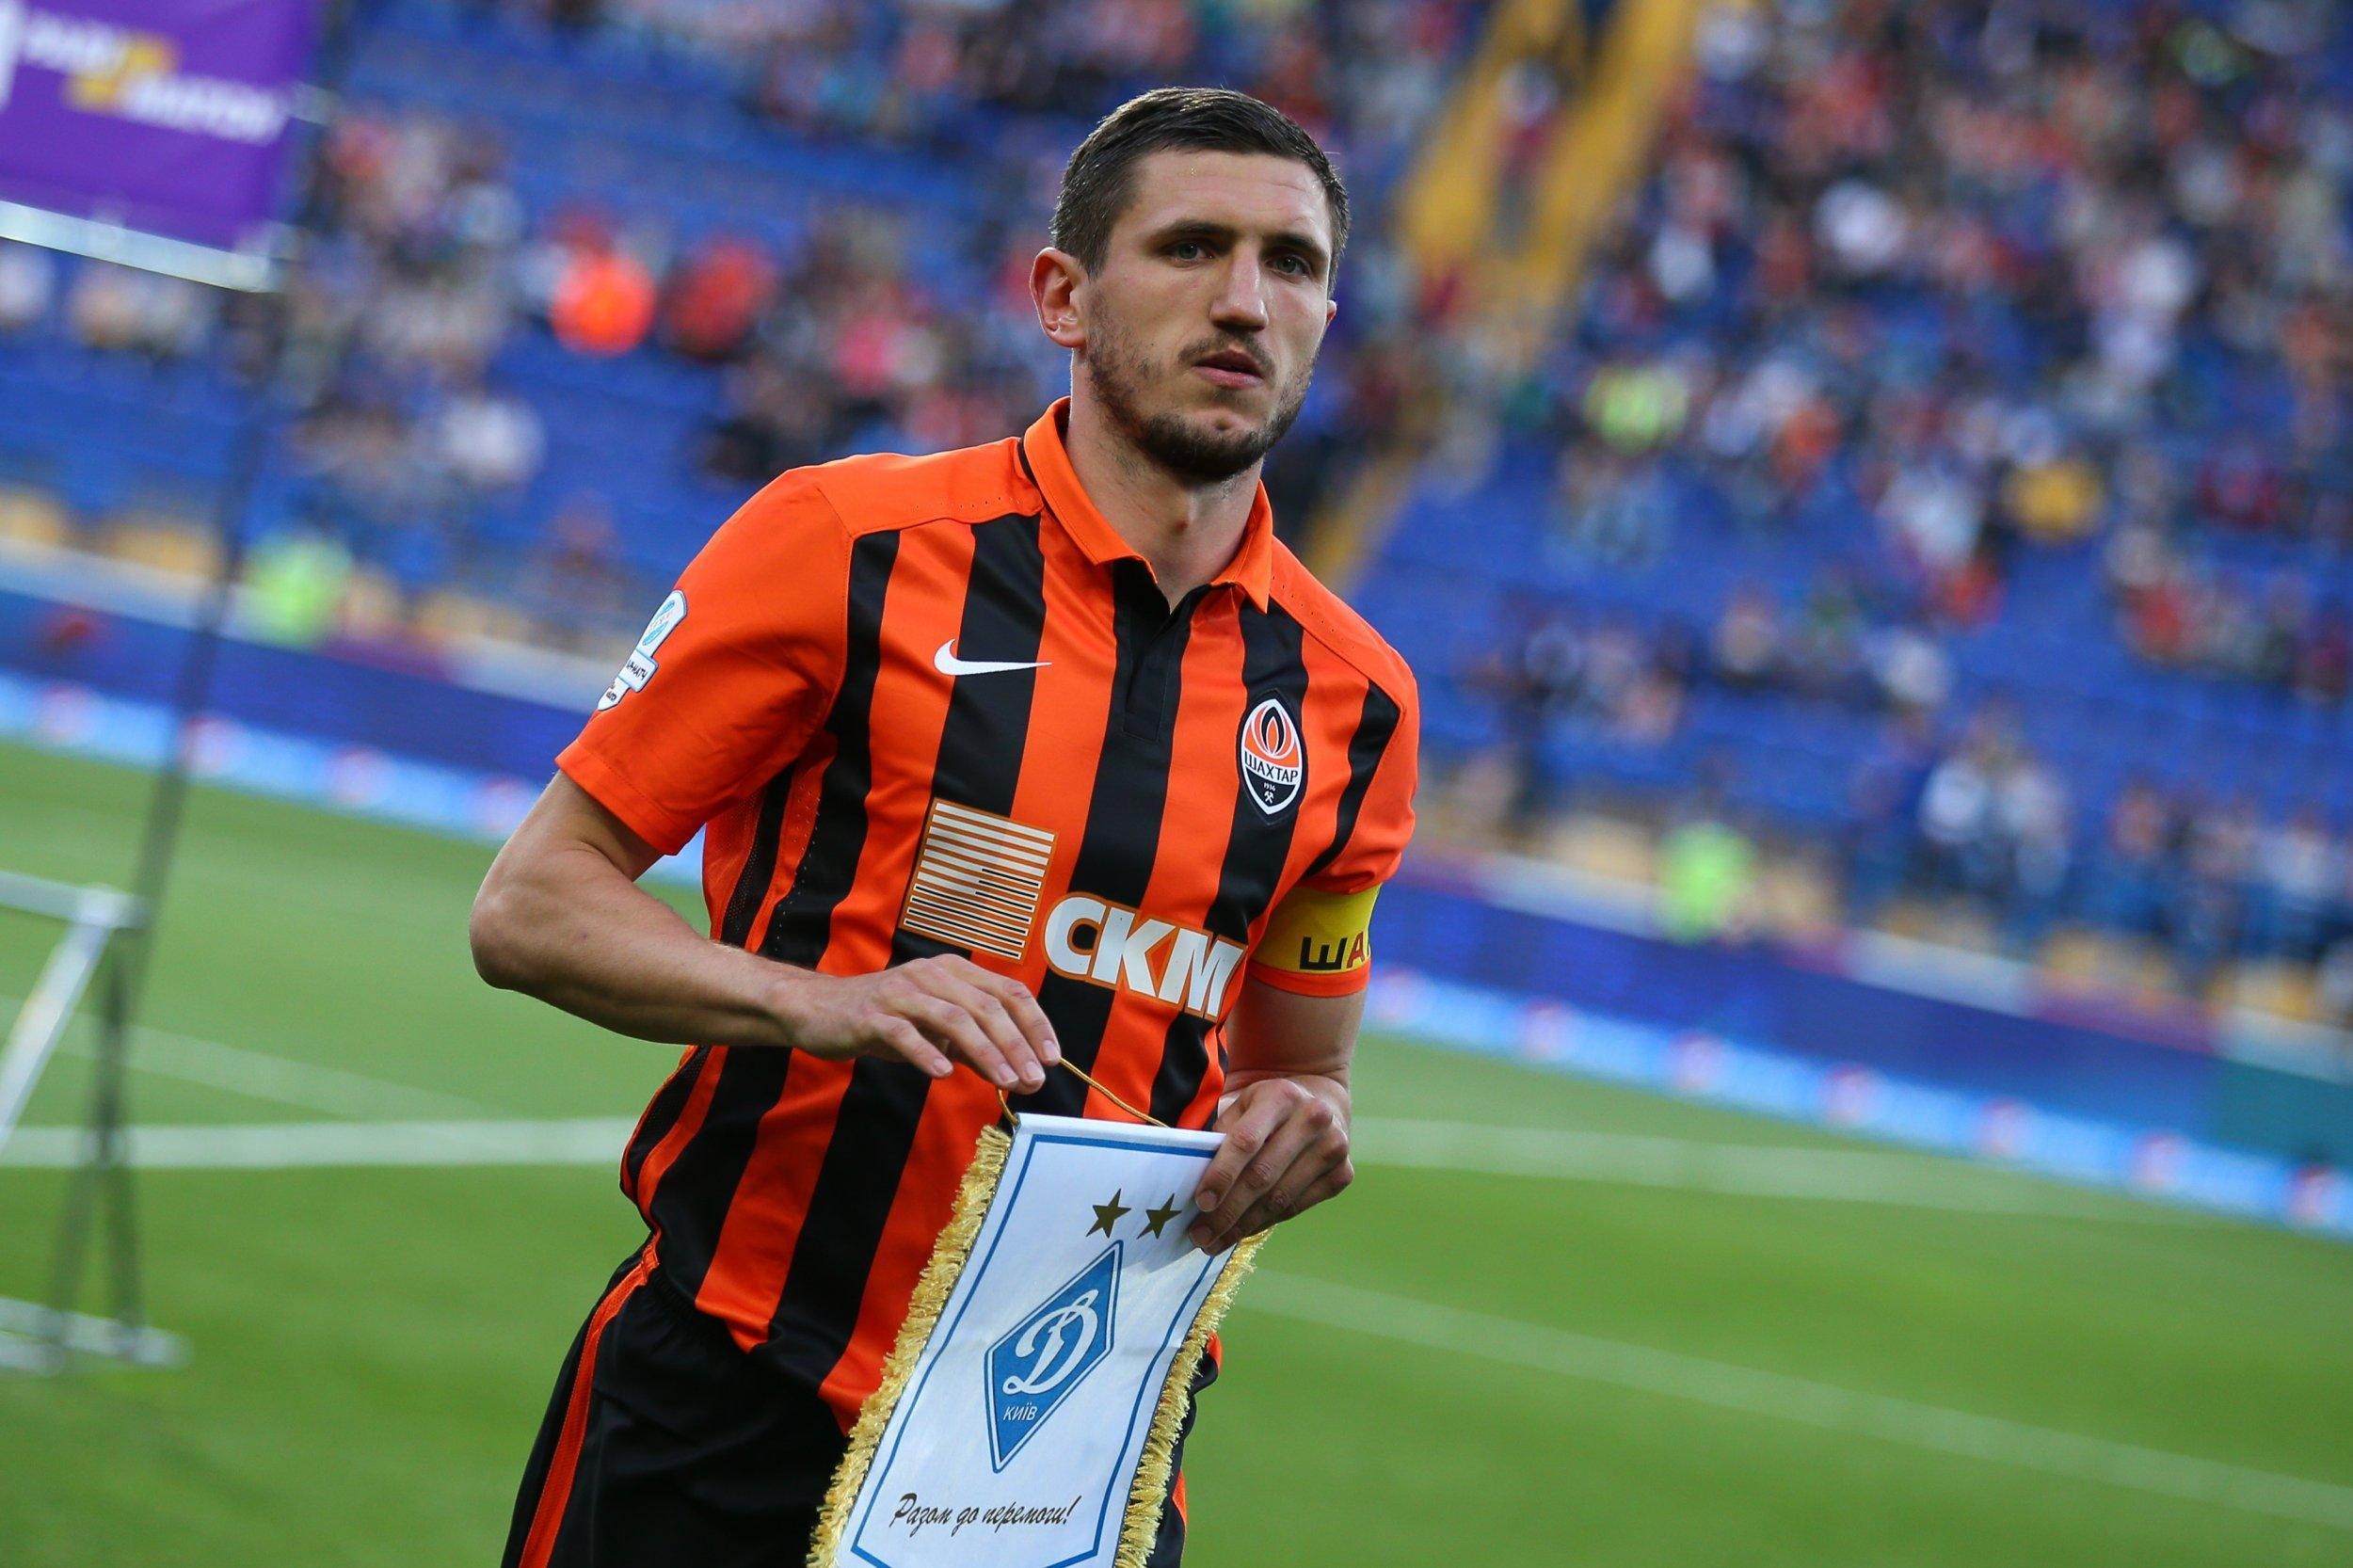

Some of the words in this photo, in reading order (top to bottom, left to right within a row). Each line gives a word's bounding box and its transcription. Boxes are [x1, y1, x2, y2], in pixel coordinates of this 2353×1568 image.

[1243, 750, 1299, 783] ШАХТАР
[1262, 782, 1276, 792] 1936
[1299, 931, 1370, 970] ША
[1002, 1401, 1038, 1421] КИЇВ
[888, 1492, 952, 1538] Разом
[951, 1506, 980, 1537] до
[981, 1495, 1082, 1534] перемоги!
